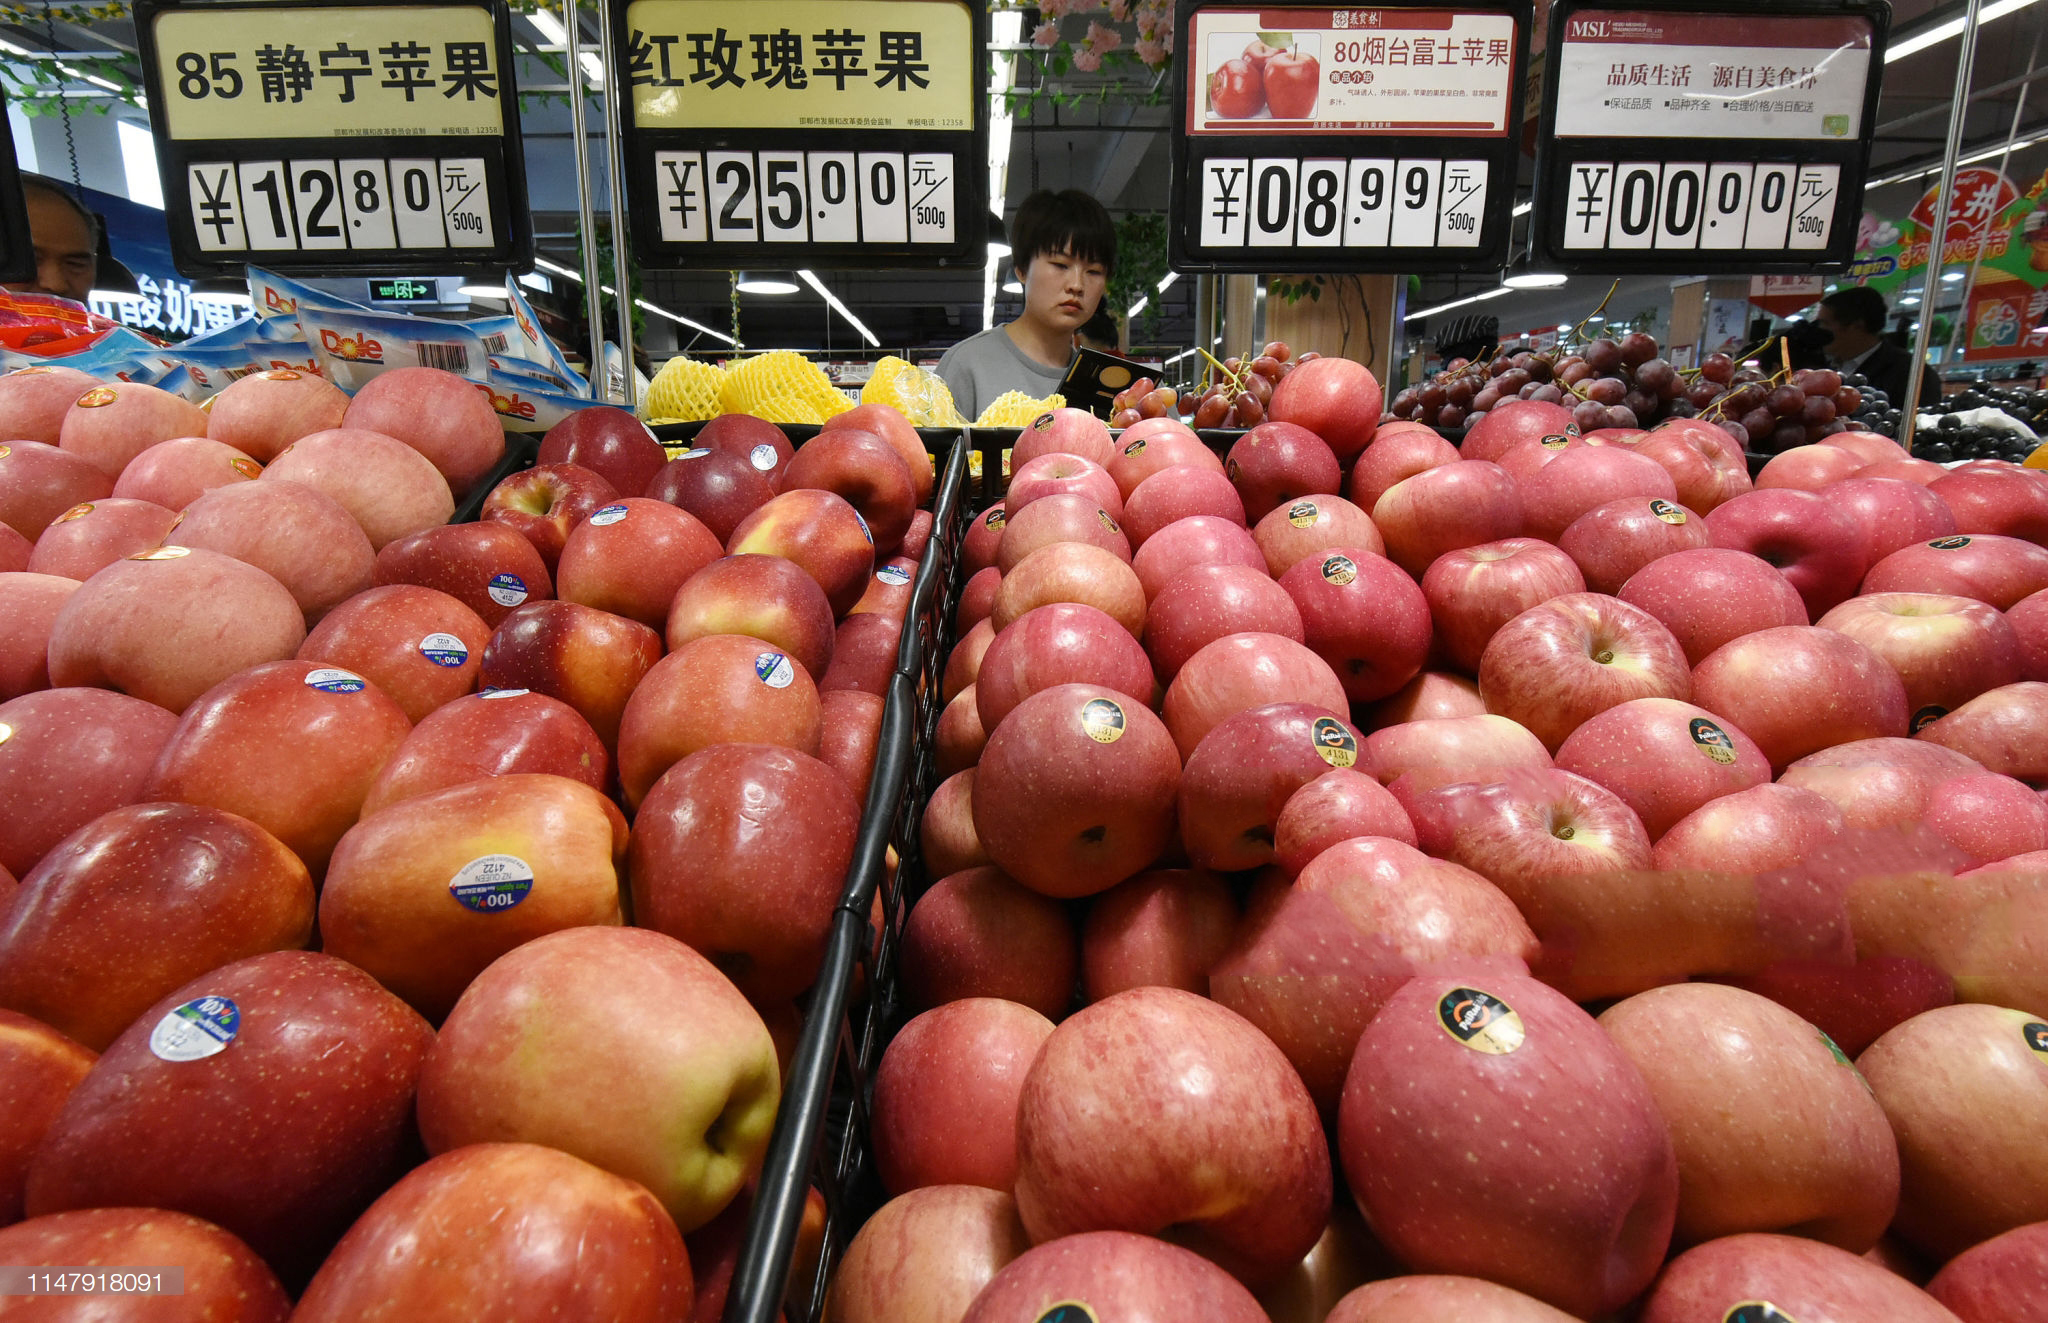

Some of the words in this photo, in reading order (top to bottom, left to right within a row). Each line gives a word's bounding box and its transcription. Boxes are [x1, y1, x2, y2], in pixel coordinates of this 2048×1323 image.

[628, 27, 931, 92] 红玫瑰苹果
[1334, 37, 1510, 67] 80烟台富士苹果
[176, 51, 243, 100] 85
[255, 41, 499, 104] 静宁苹果
[1329, 71, 1374, 84] 商品介绍
[1607, 63, 1692, 87] 品质生活
[1712, 65, 1818, 90] 源自美食林
[1610, 98, 1653, 110] 保证品质
[1669, 99, 1711, 111] 品种齐全
[1729, 100, 1814, 113] 合理价格/当日配送
[511, 295, 539, 342] Dole
[320, 328, 383, 361] Dole
[1326, 749, 1349, 761] 4131
[475, 873, 501, 883] QUEEN
[483, 863, 505, 874] 4122
[501, 872, 512, 881] NZ
